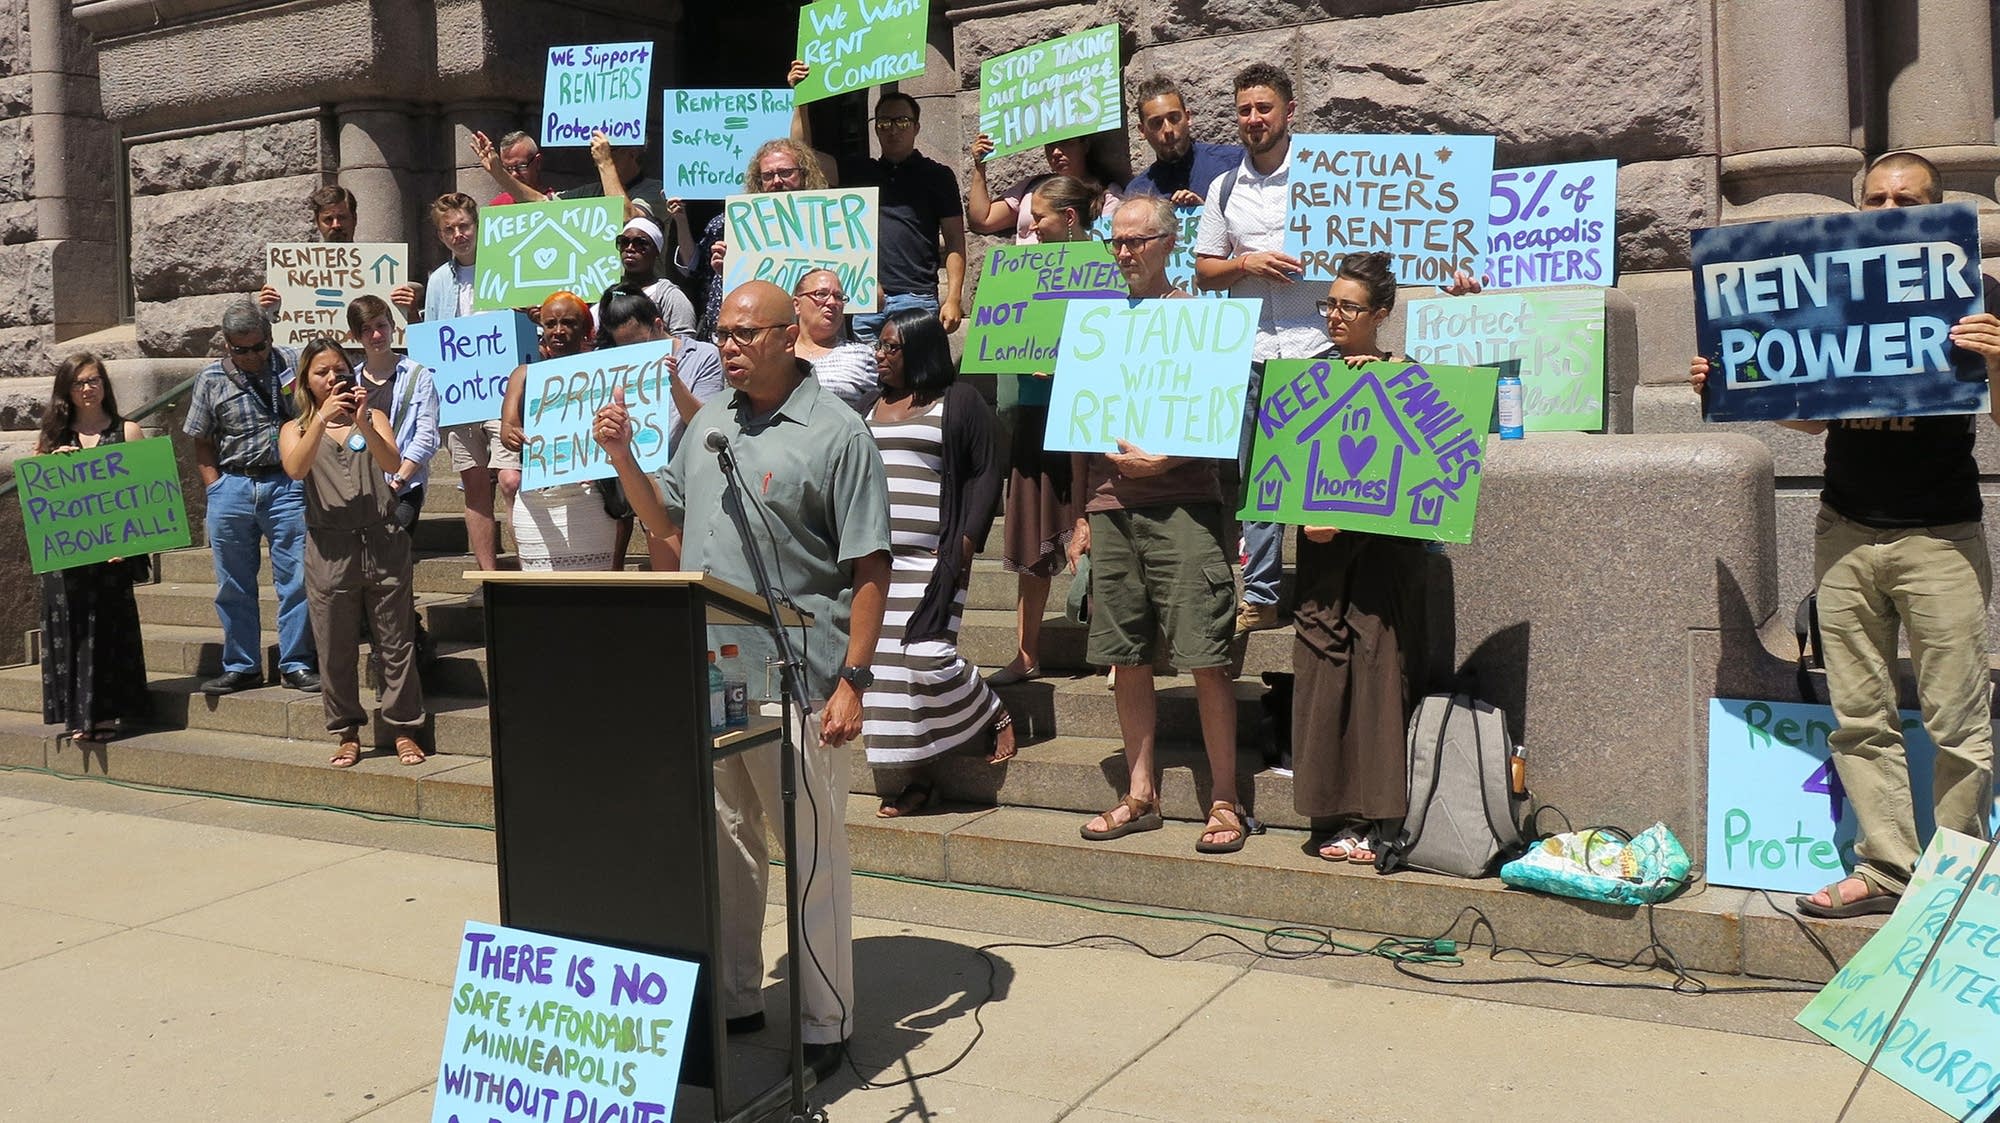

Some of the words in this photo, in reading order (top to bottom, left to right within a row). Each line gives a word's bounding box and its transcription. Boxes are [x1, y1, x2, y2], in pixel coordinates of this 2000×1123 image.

[809, 3, 848, 36] We
[551, 48, 575, 66] WE
[582, 46, 649, 73] Support
[804, 27, 872, 64] RENT
[988, 49, 1045, 87] STOP
[1050, 30, 1115, 68] TAKING
[559, 66, 643, 106] RENTERS
[824, 50, 925, 93] CONTROL
[988, 85, 1017, 109] our
[1003, 84, 1101, 147] HOMES
[671, 128, 734, 152] Saftey
[678, 160, 745, 187] Afforda
[1291, 180, 1459, 213] RENTERS
[1488, 169, 1558, 227] 5%
[1560, 175, 1595, 213] of
[484, 210, 544, 247] KEEP
[727, 193, 872, 252] RENTER
[1289, 213, 1312, 246] 4
[1326, 214, 1479, 256] RENTER
[1487, 217, 1604, 254] neapolis
[270, 247, 362, 268] RENTERS
[990, 244, 1070, 277] Protect
[1299, 249, 1475, 282] PROTIONS
[1484, 247, 1602, 288] RENTERS
[287, 268, 365, 289] RIGHTS
[479, 268, 510, 303] IN
[558, 255, 622, 297] OMES
[1702, 241, 1976, 321] RENTER
[271, 309, 338, 326] SAFETY
[975, 302, 1029, 327] NOT
[1073, 300, 1250, 362] STAND
[1417, 300, 1537, 341] Protect
[438, 325, 507, 362] Rent
[1720, 316, 1951, 390] POWER
[428, 368, 510, 404] ontro
[533, 353, 670, 427] PROTECT
[1119, 358, 1193, 393] WITH
[1069, 383, 1247, 446] RENTERS
[1258, 361, 1332, 440] KEEP
[1385, 364, 1482, 491] FAMILIES
[1341, 404, 1371, 432] in
[527, 412, 664, 481] RENRS
[20, 451, 130, 497] RENTER
[1316, 469, 1387, 502] homes
[27, 475, 181, 525] PROTECTION
[43, 522, 116, 562] ABOVE
[122, 508, 178, 544] ALL!
[1724, 808, 1855, 872] Protec
[1907, 887, 2000, 959] PROTEC
[464, 932, 558, 985] THERE
[565, 954, 597, 999] IS
[610, 962, 668, 1006] NO
[1834, 967, 1875, 992] NOT
[453, 982, 512, 1028] SAFE
[526, 1000, 673, 1058] AFFORDABLE
[462, 1024, 638, 1097] MINNEAPOLIS
[444, 1063, 560, 1123] WITHOUT
